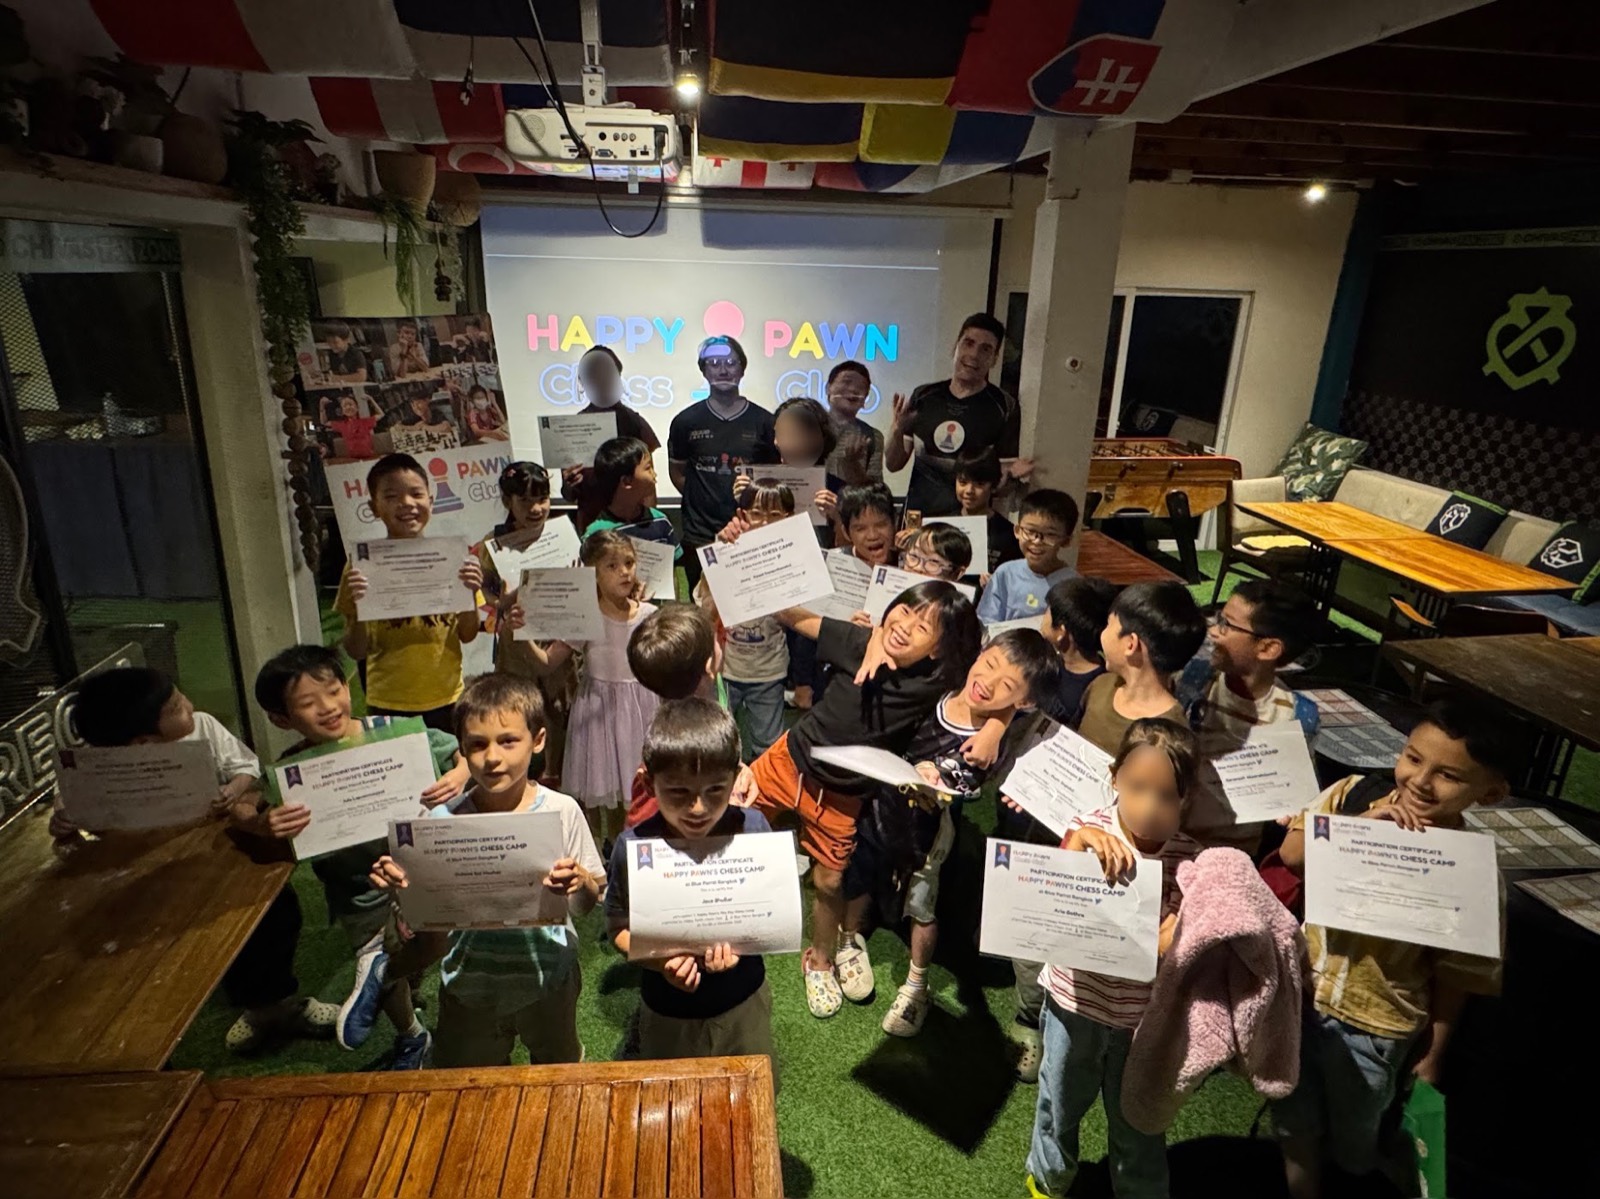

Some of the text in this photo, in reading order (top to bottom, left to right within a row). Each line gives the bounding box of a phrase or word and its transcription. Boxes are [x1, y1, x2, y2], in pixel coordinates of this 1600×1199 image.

[527, 313, 898, 361] HAPPY PAWN
[540, 362, 674, 407] Css
[457, 455, 513, 480] PAWN
[468, 481, 502, 503] Clu
[434, 837, 477, 845] PARTICIPATION
[1351, 839, 1441, 856] PARTICIPATION CERTIFICATE
[1400, 855, 1427, 864] CHESS
[1430, 858, 1455, 867] CAMP
[690, 868, 717, 876] PAWN'S
[1030, 868, 1108, 884] PARTICIPATION CERTIFICA
[1018, 875, 1124, 897] HAPPY PAWN'S CHESS CAMP
